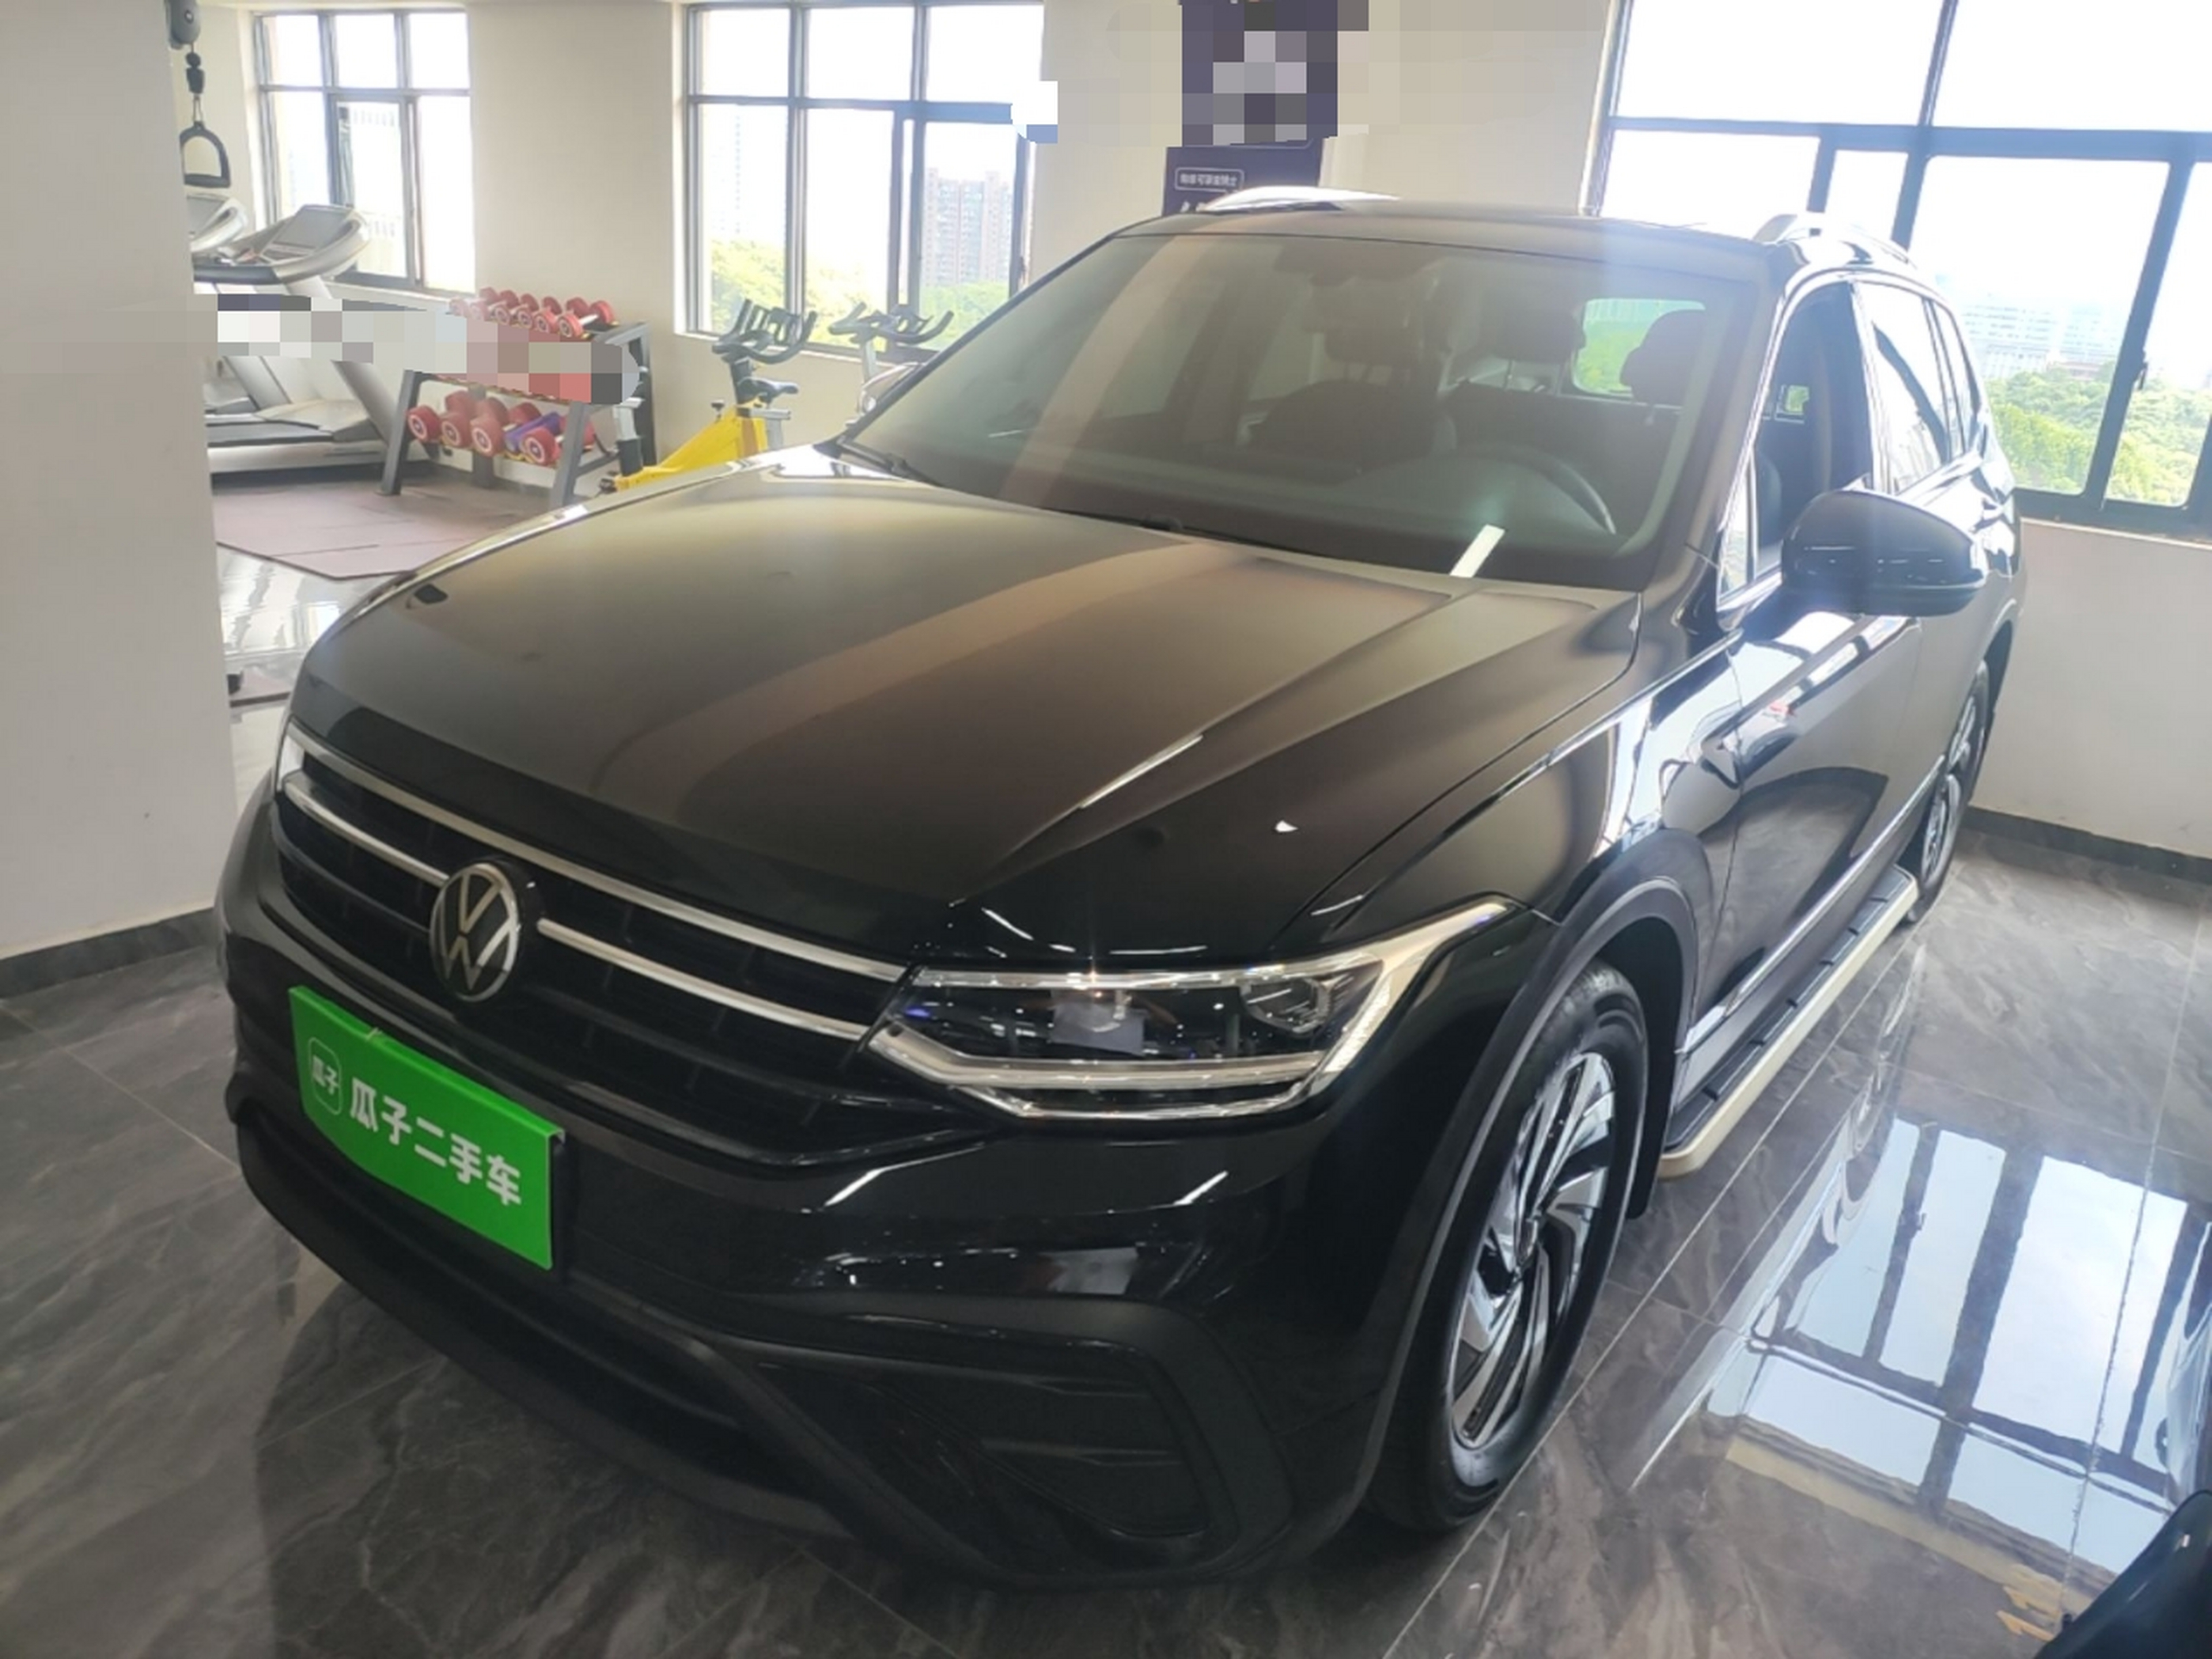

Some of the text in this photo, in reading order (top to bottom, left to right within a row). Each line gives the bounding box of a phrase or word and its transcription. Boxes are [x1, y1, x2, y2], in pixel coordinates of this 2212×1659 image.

[350, 1077, 521, 1206] 瓜子二手车
